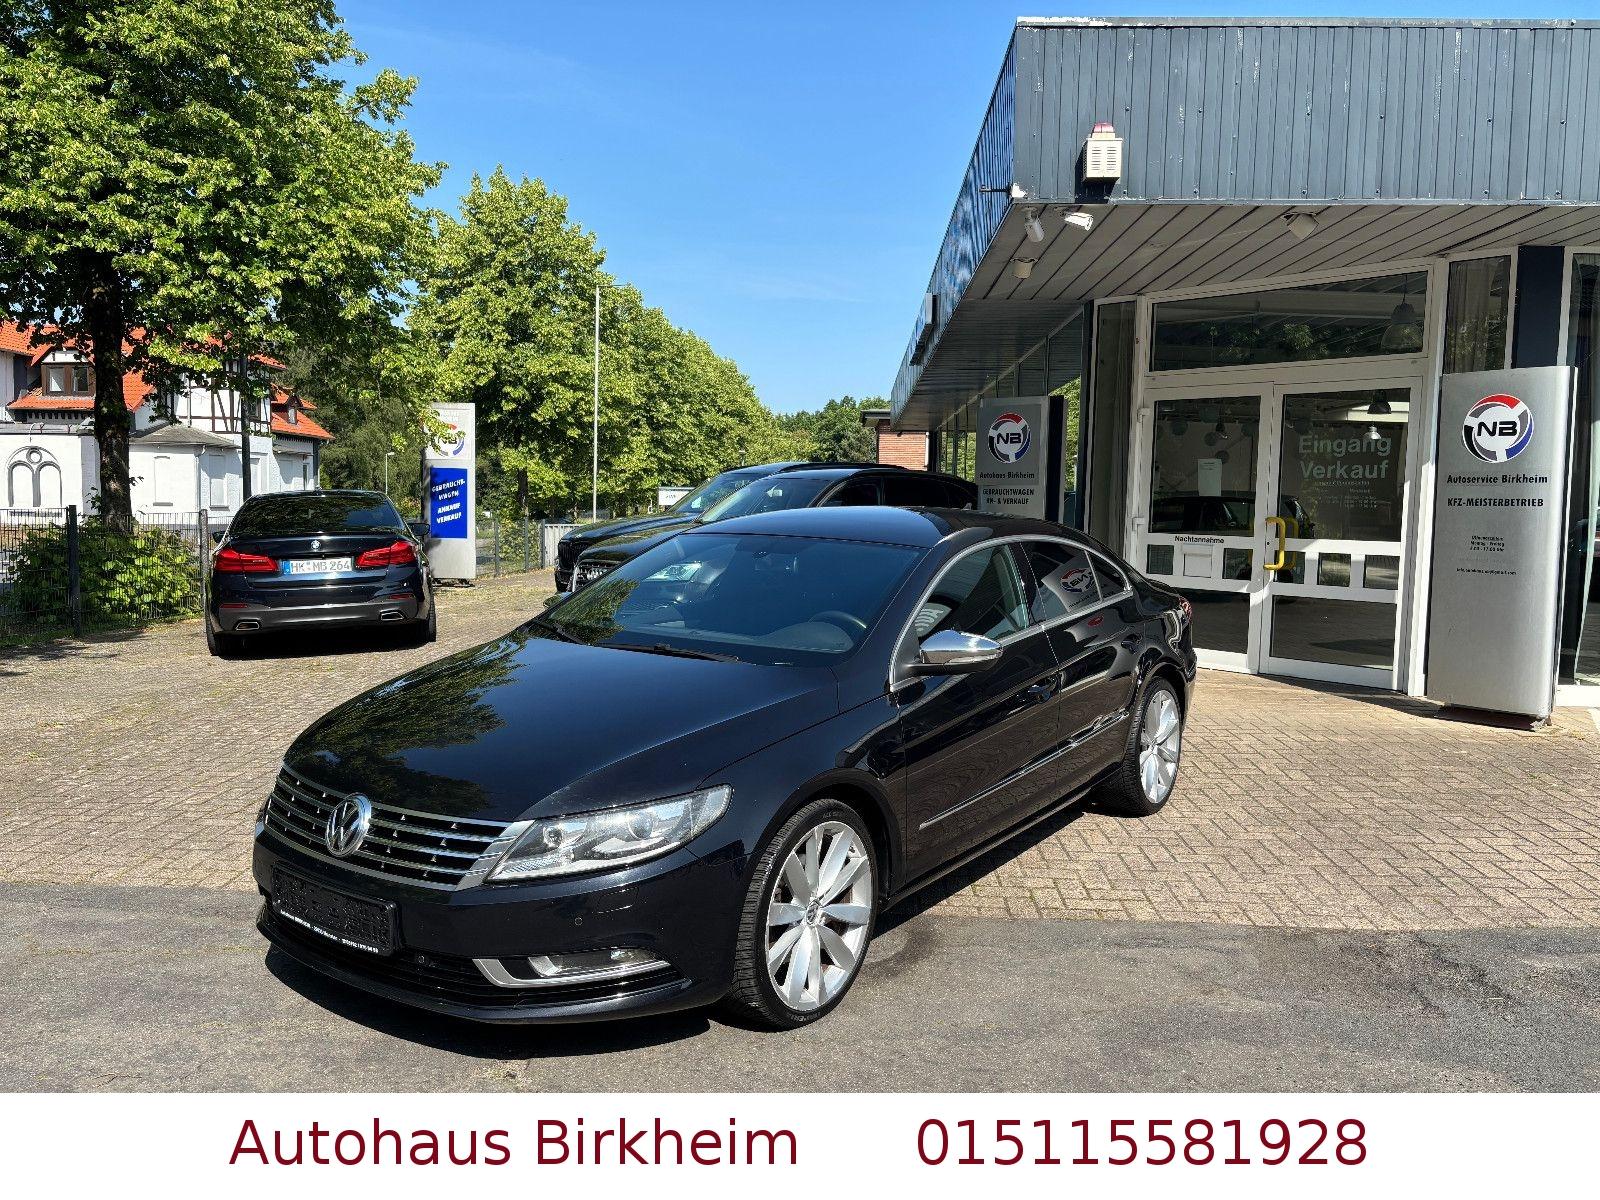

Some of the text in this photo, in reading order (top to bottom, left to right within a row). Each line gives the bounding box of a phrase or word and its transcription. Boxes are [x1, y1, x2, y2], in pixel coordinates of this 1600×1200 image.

[1477, 420, 1518, 437] NB
[996, 432, 1022, 445] NB
[1299, 433, 1392, 458] Eingang
[1299, 460, 1389, 479] Verkauf
[1447, 474, 1548, 484] Autoservice Birkheim
[983, 488, 1035, 496] GEBRAUCHTWAGEN
[437, 502, 461, 514] ANKAUF
[1447, 498, 1544, 507] KFZ-MEISTERBETRIEB
[436, 511, 462, 524] VERKAUF
[1174, 535, 1225, 544] Nachtannahme
[291, 562, 305, 573] HK
[329, 560, 350, 571] 264
